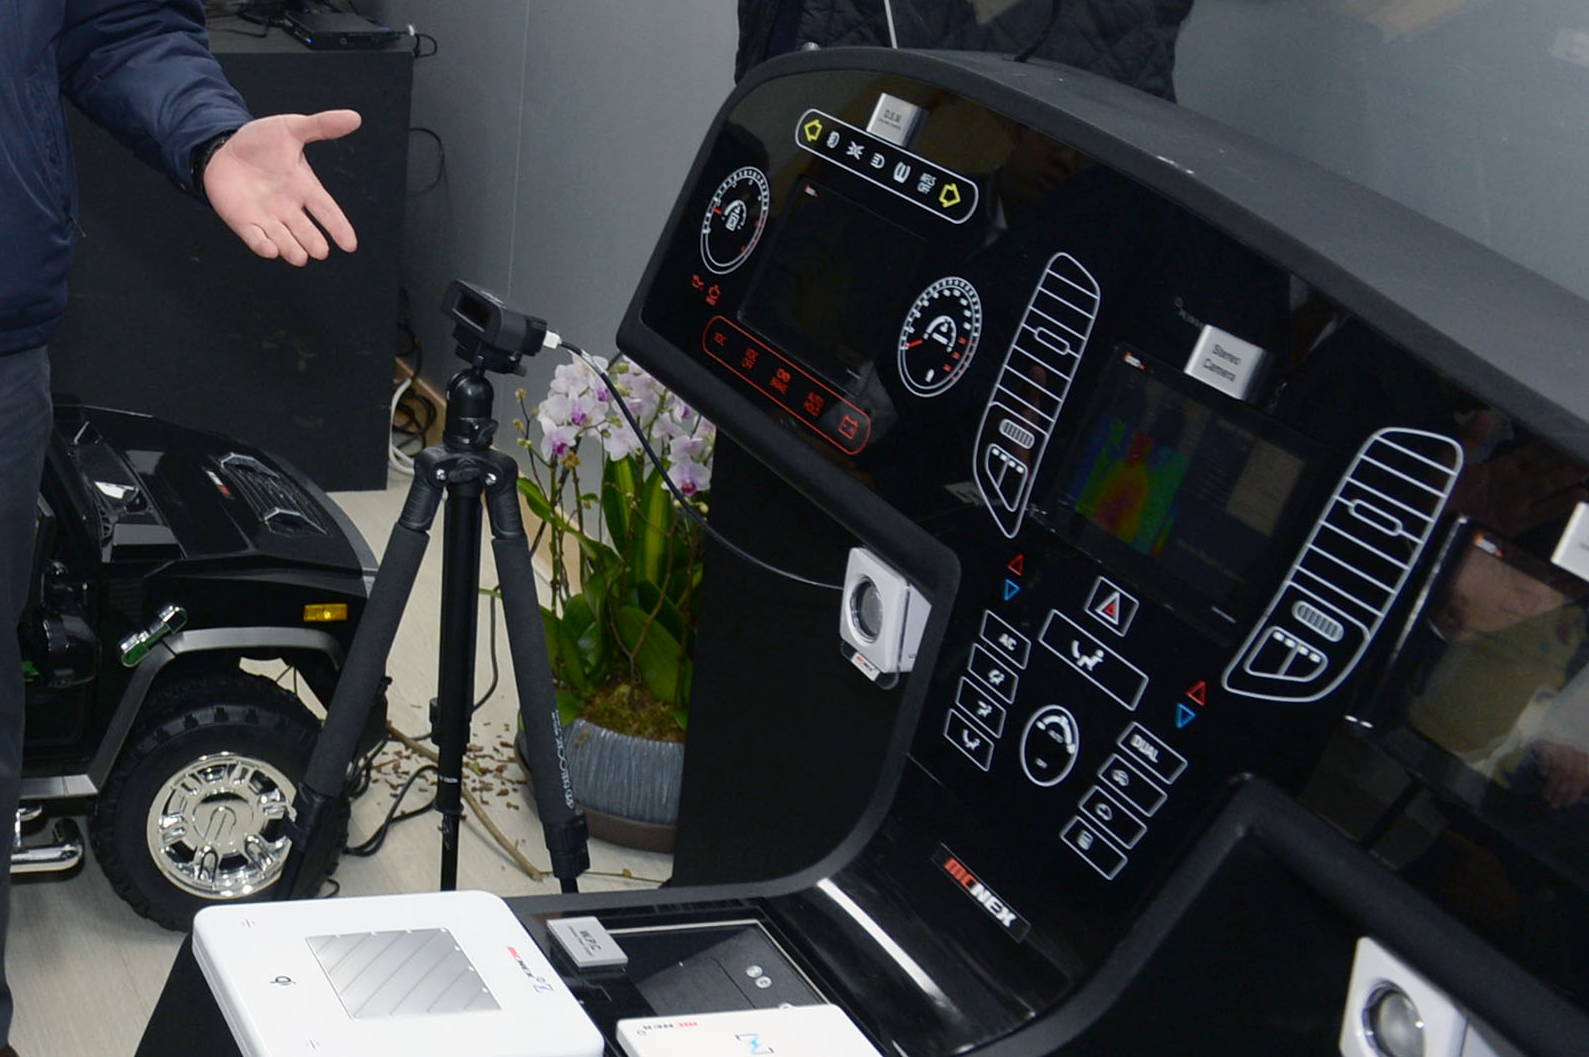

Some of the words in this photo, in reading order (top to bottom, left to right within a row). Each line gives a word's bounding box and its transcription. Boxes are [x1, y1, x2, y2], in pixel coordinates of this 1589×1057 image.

[1212, 344, 1242, 366] Stereo
[1203, 358, 1237, 383] Camera
[944, 857, 1017, 928] MCNEX
